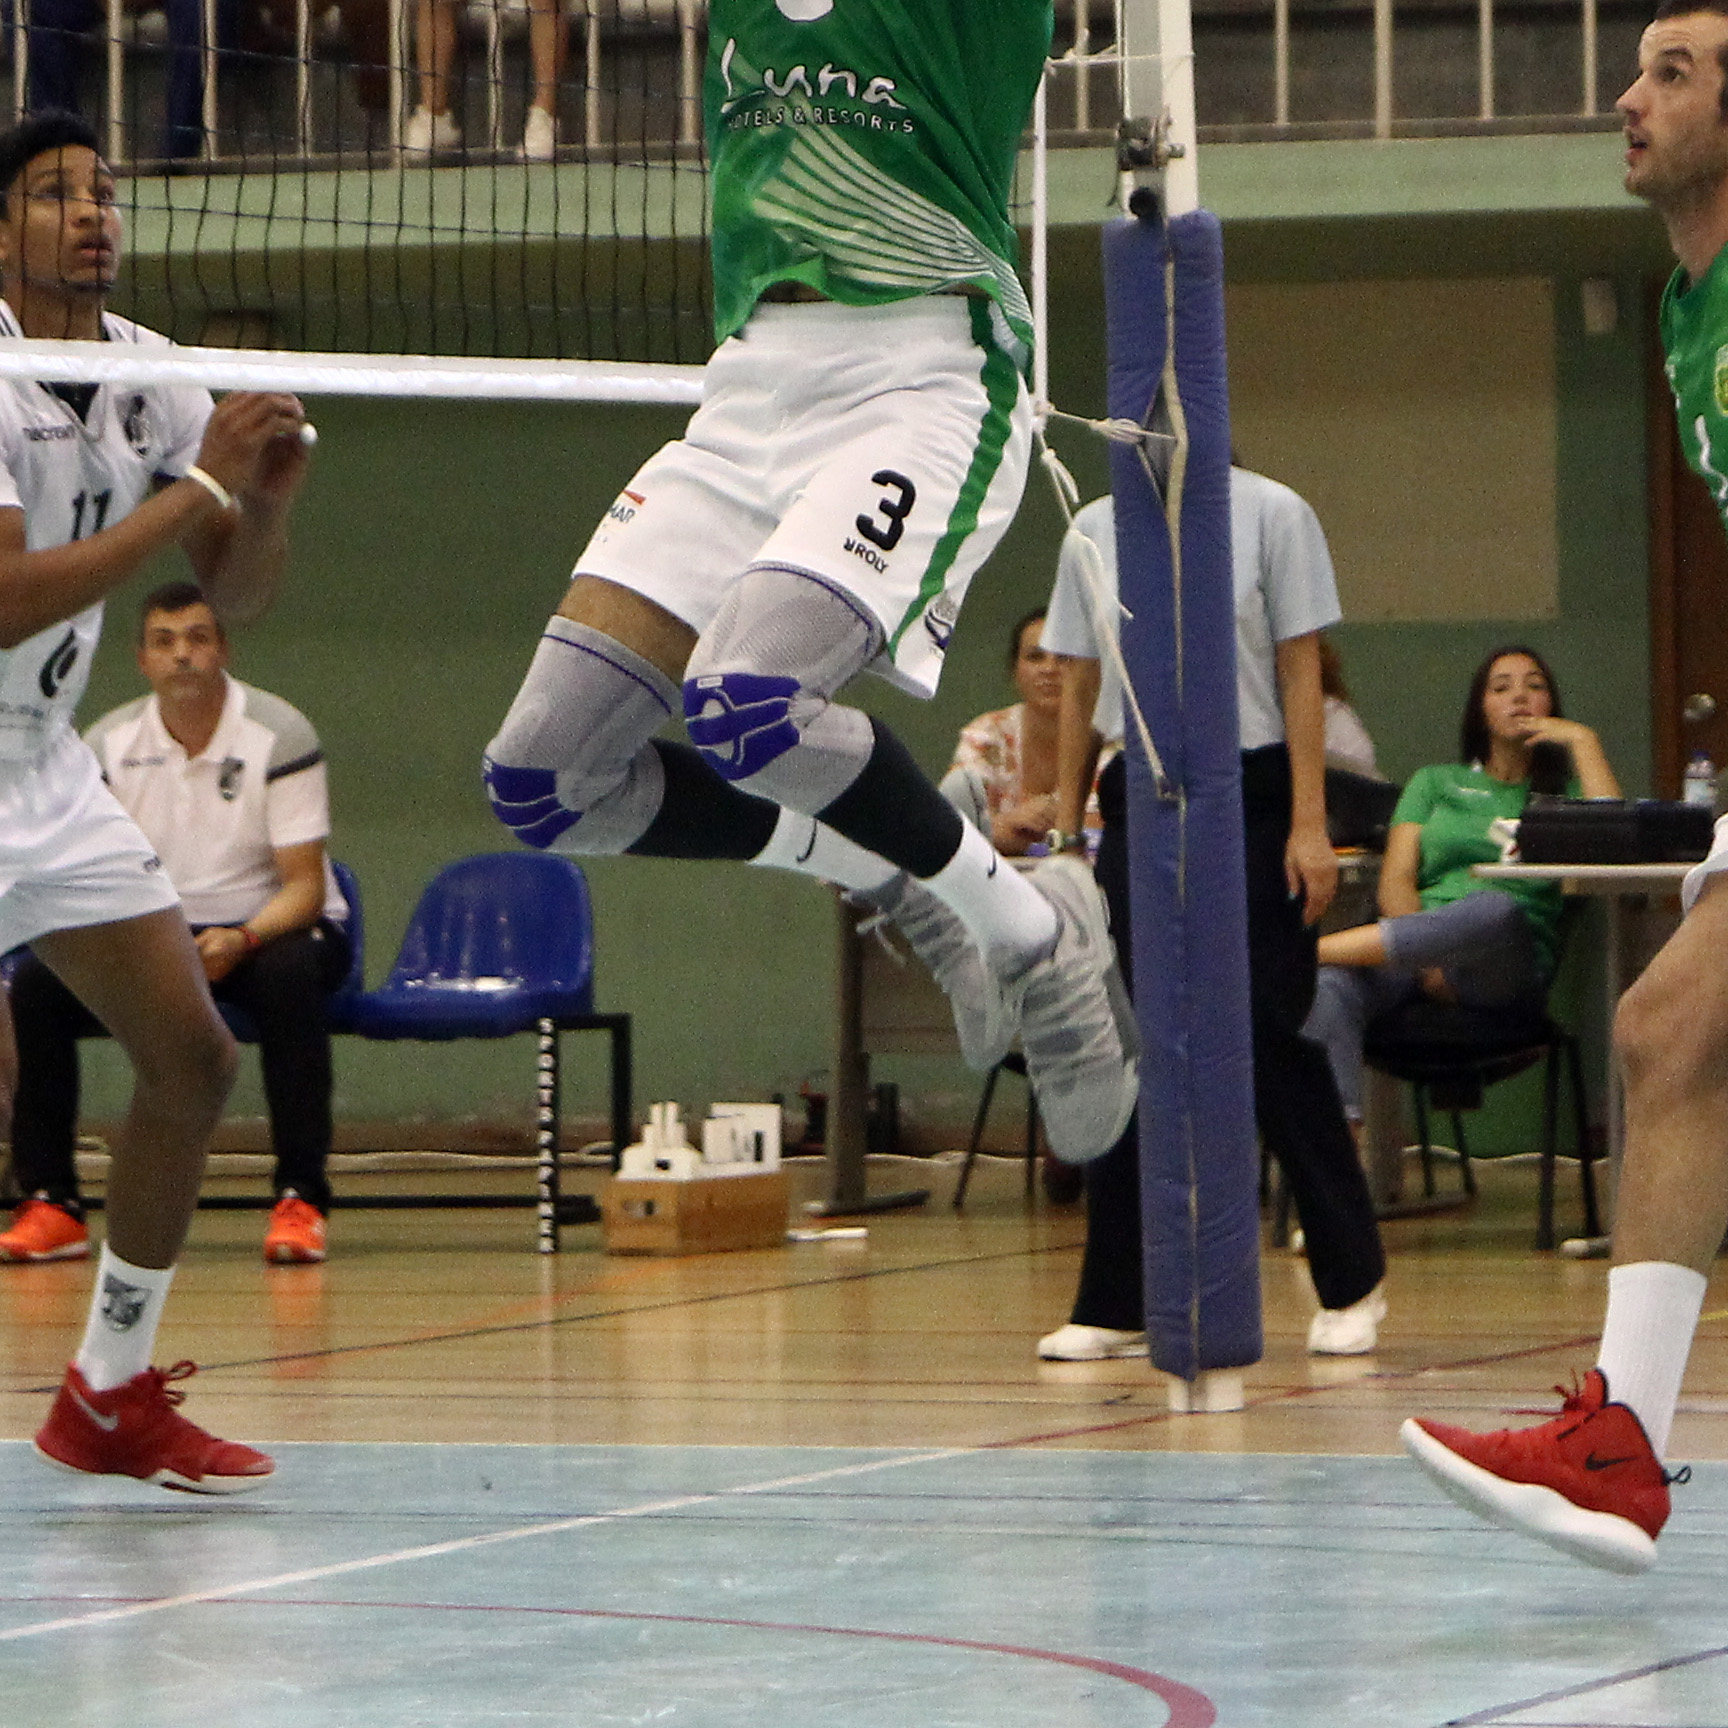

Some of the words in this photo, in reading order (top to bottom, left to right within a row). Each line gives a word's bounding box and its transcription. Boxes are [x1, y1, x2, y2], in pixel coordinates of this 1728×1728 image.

[721, 37, 908, 114] Luna
[793, 105, 807, 124] &
[813, 106, 915, 134] RESORTS
[73, 487, 113, 541] 11
[855, 469, 917, 552] 3
